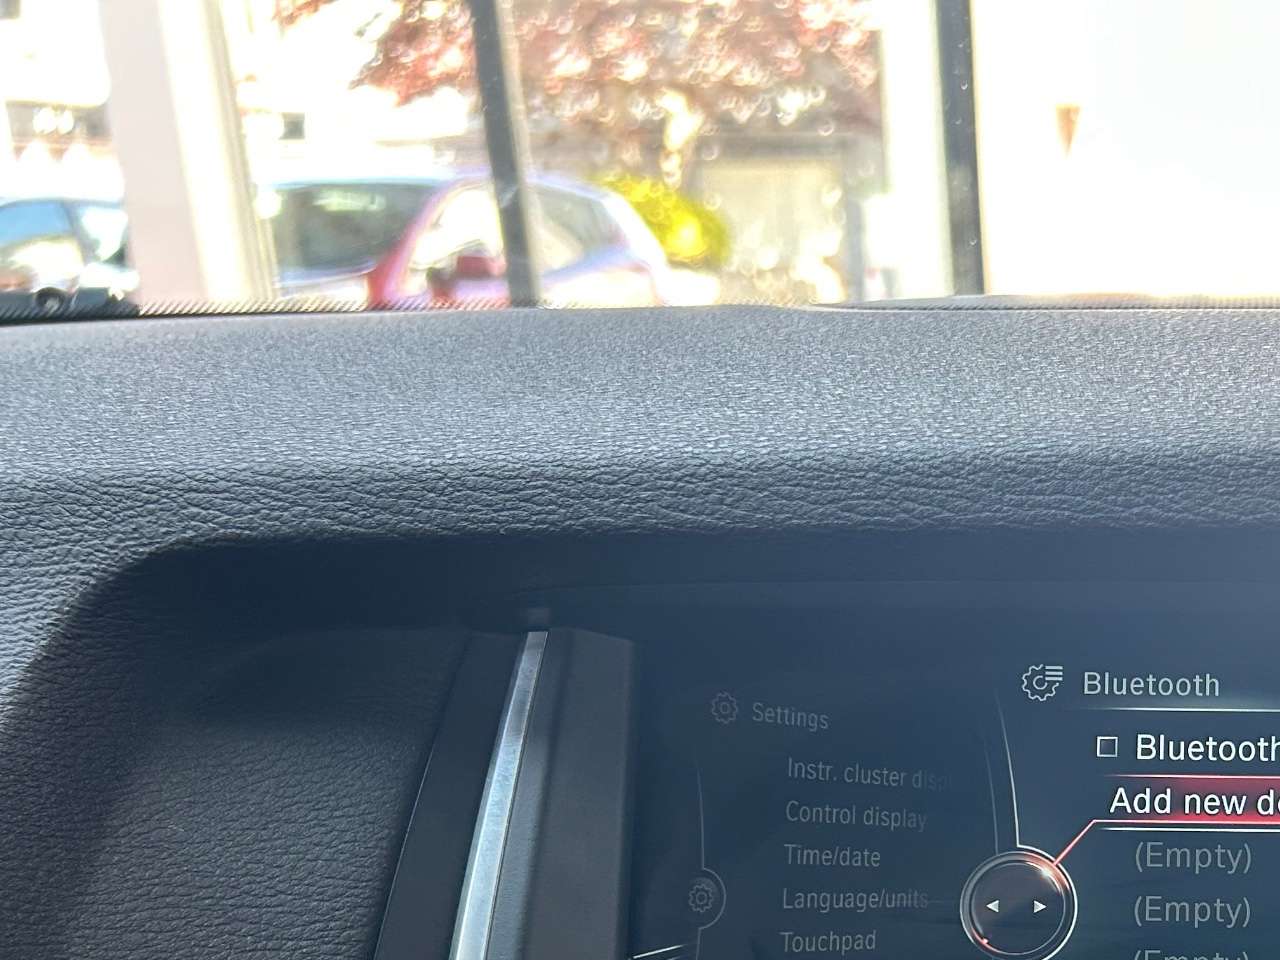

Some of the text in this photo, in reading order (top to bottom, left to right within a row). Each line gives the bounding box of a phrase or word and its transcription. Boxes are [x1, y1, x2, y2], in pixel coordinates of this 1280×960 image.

[1083, 671, 1220, 697] Bluetooth
[751, 702, 830, 732] Settings
[787, 757, 838, 782] Instr.
[843, 763, 907, 787] cluster
[1109, 787, 1172, 814] Add
[1184, 793, 1247, 815] new
[785, 800, 928, 833] Control display
[783, 843, 881, 867] Time/date
[1135, 841, 1251, 874] (Empty)
[782, 887, 929, 913] Language/units
[1134, 895, 1251, 928] (Empty)
[779, 929, 877, 956] Touchpad
